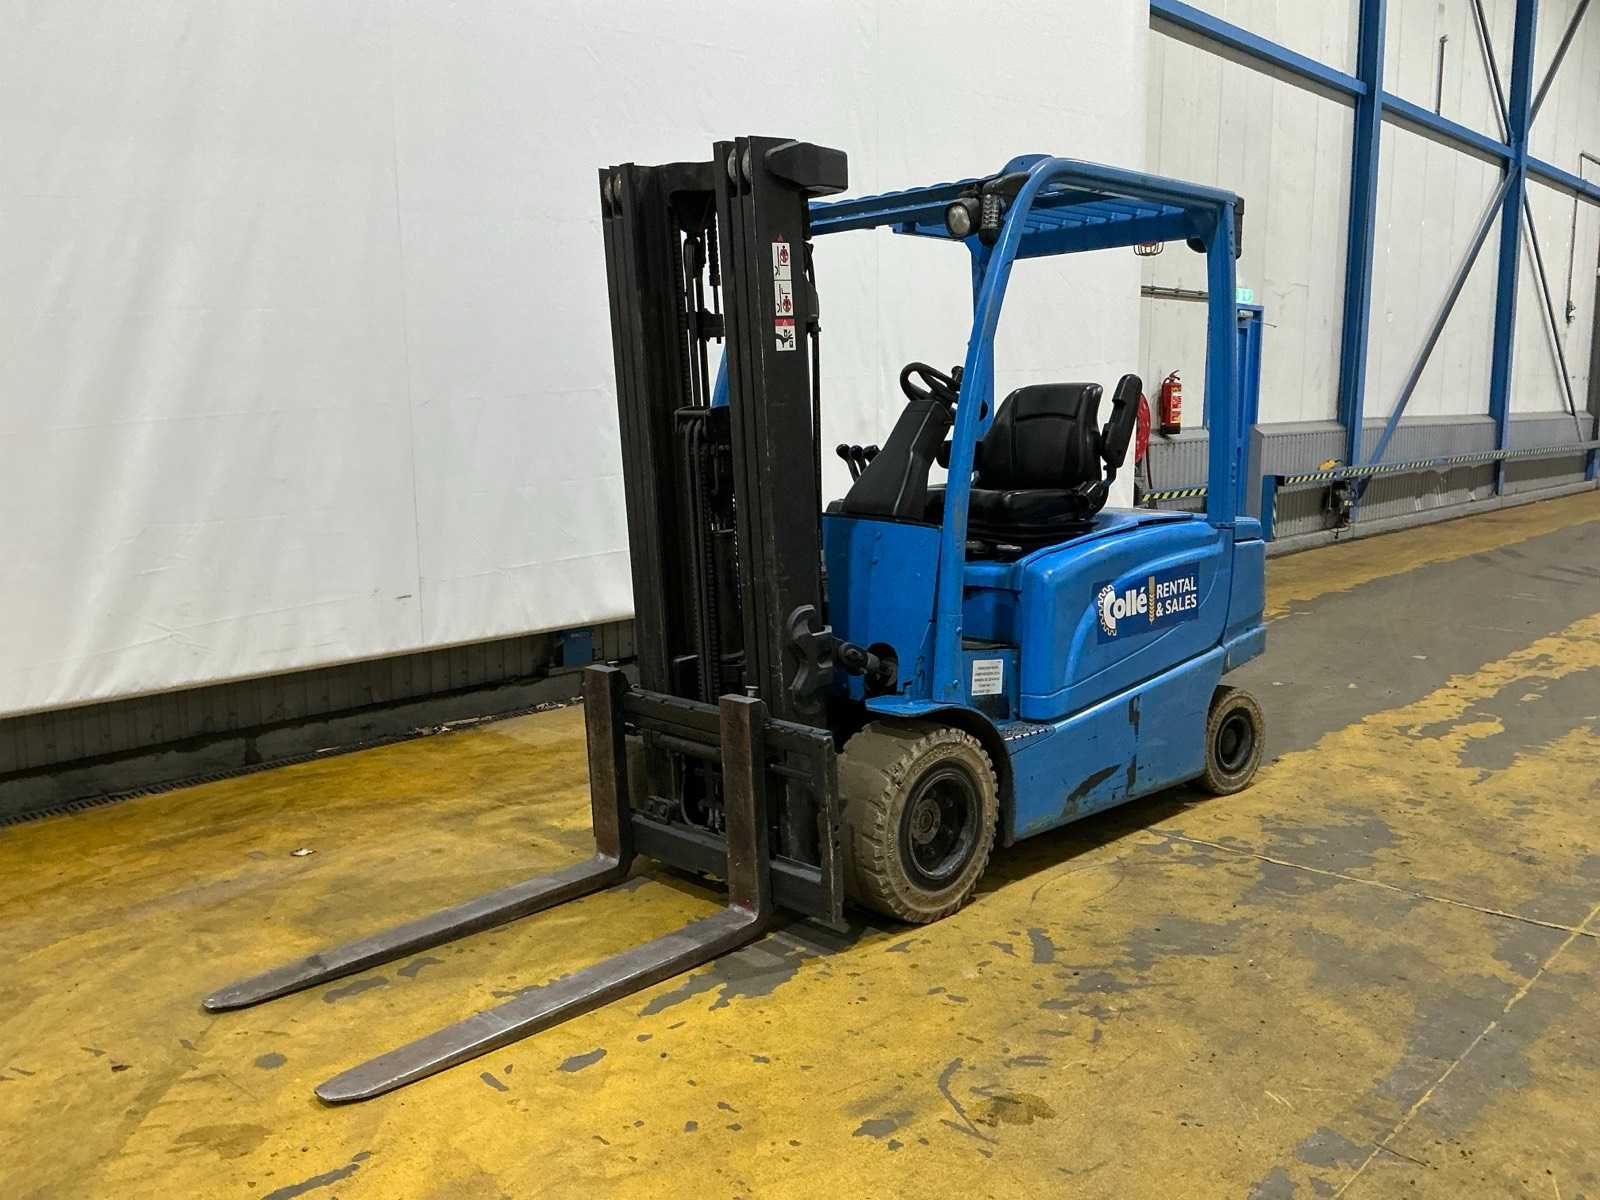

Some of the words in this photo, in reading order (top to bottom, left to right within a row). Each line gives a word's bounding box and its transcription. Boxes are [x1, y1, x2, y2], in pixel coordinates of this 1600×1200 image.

[1156, 576, 1197, 599] RENTAL
[1103, 587, 1148, 630] Collé
[1155, 602, 1164, 617] &
[1165, 593, 1197, 614] SALES
